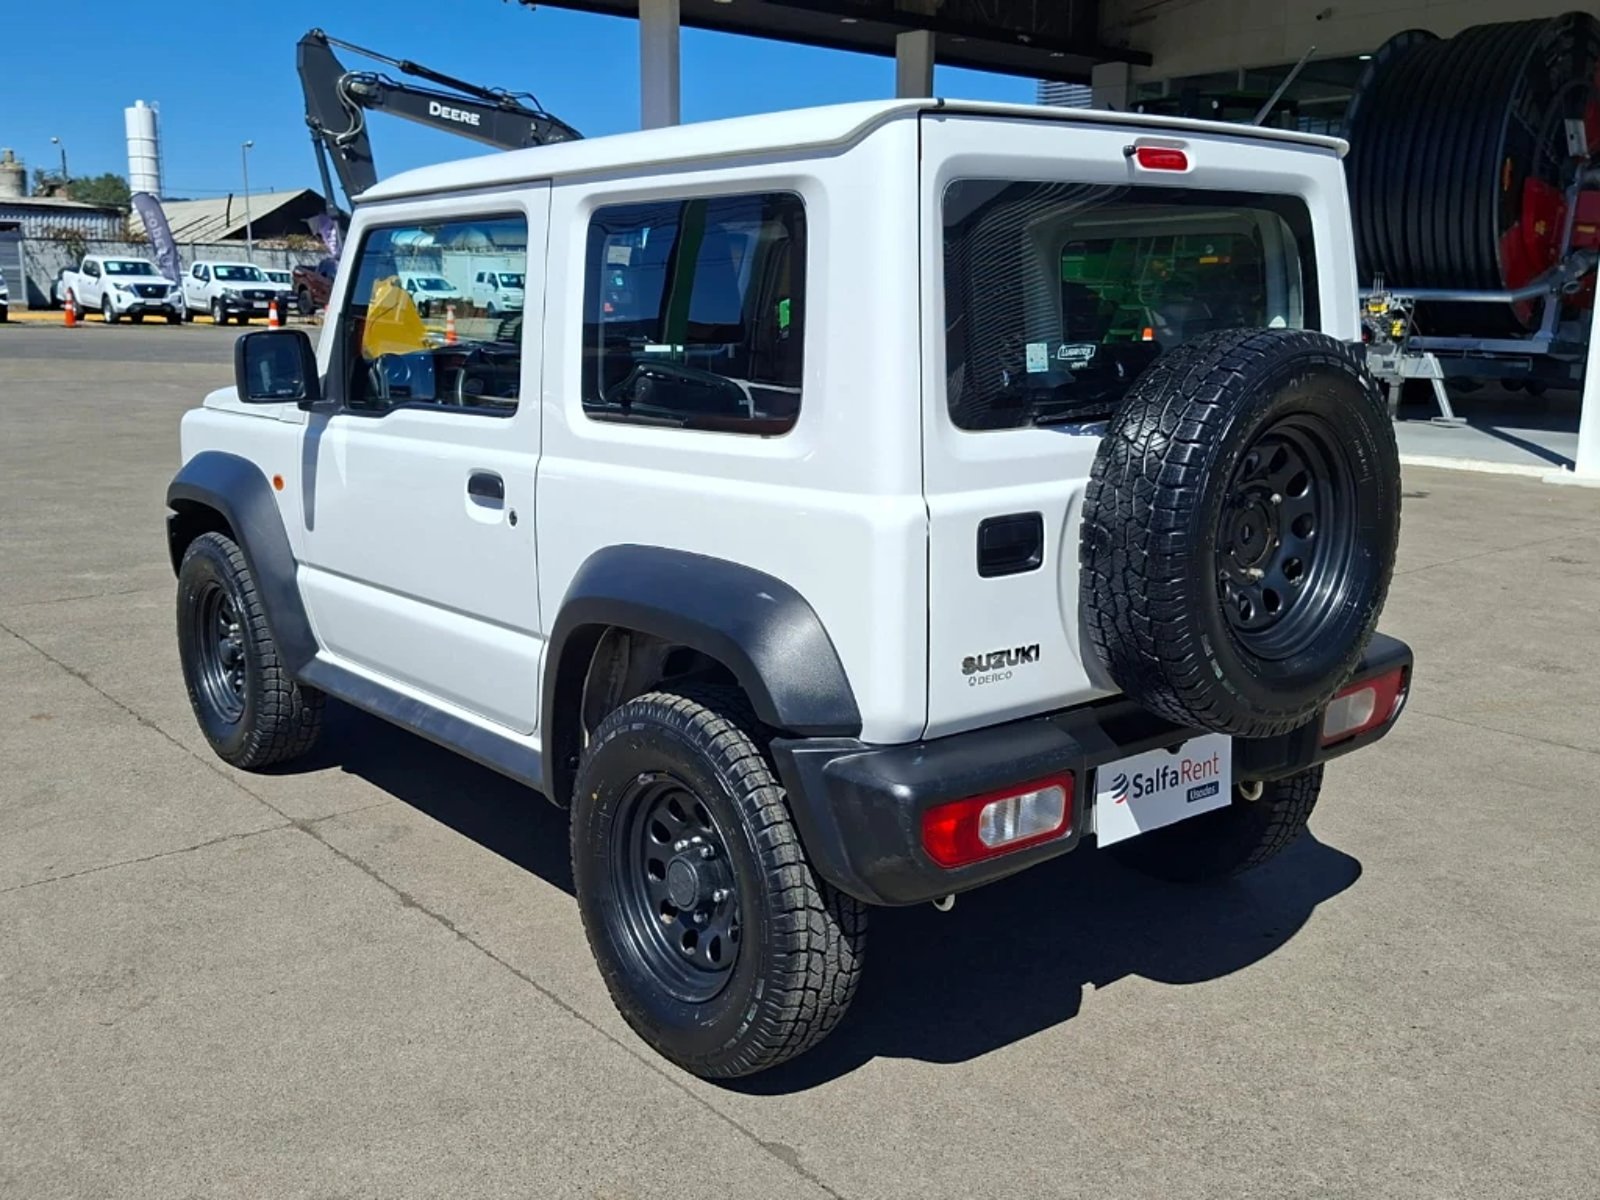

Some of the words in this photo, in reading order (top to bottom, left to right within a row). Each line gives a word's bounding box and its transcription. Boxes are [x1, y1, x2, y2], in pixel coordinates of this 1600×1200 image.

[429, 101, 480, 126] DEERE
[962, 643, 1040, 675] SUZUKI
[977, 671, 1013, 685] DERCO
[1132, 752, 1219, 799] SalfaRent
